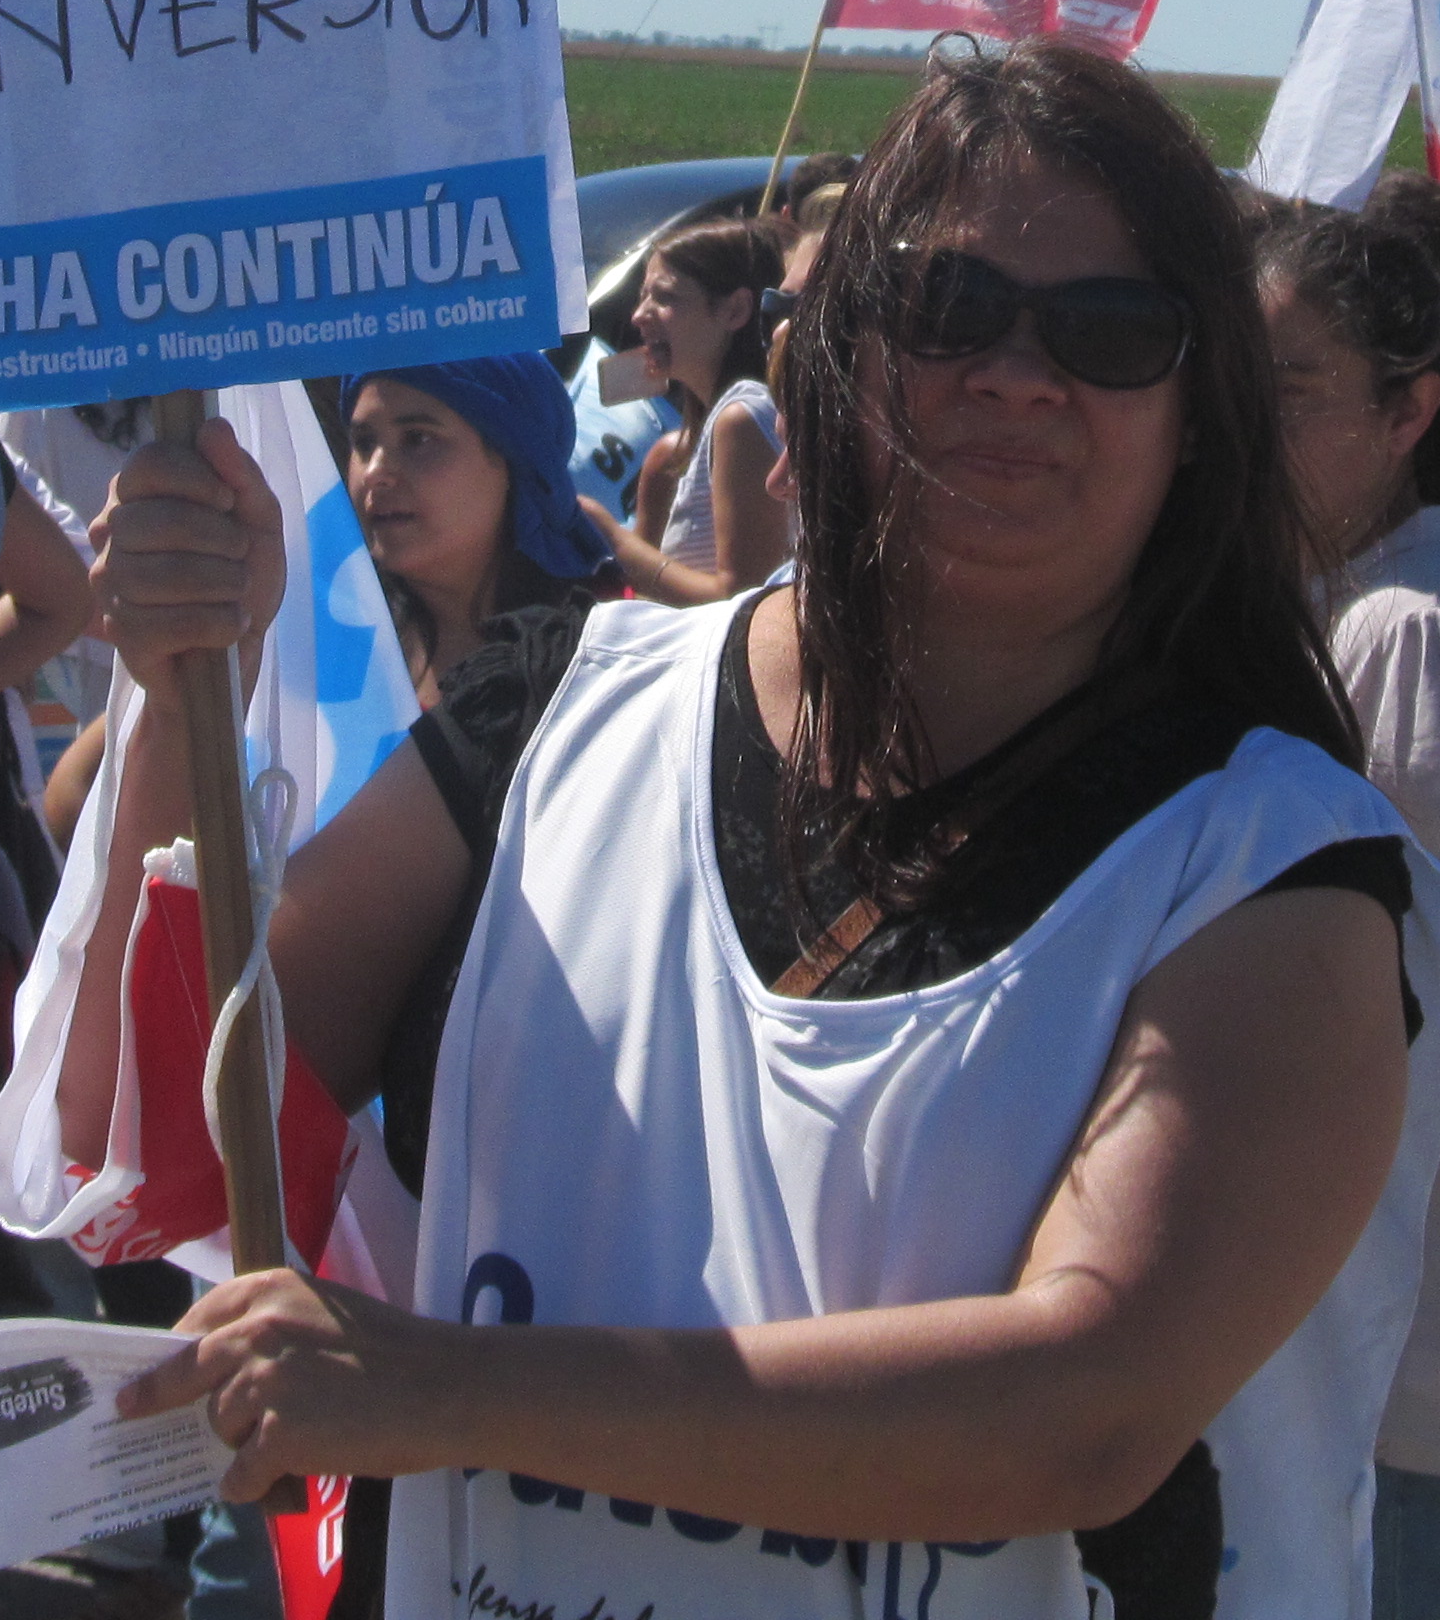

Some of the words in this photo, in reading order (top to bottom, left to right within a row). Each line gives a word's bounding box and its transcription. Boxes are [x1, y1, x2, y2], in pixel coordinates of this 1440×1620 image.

[114, 183, 520, 320] CONTINÚA
[160, 326, 260, 363] Ningún
[267, 315, 379, 348] Docente
[386, 305, 429, 336] sin
[435, 294, 528, 327] cobrar
